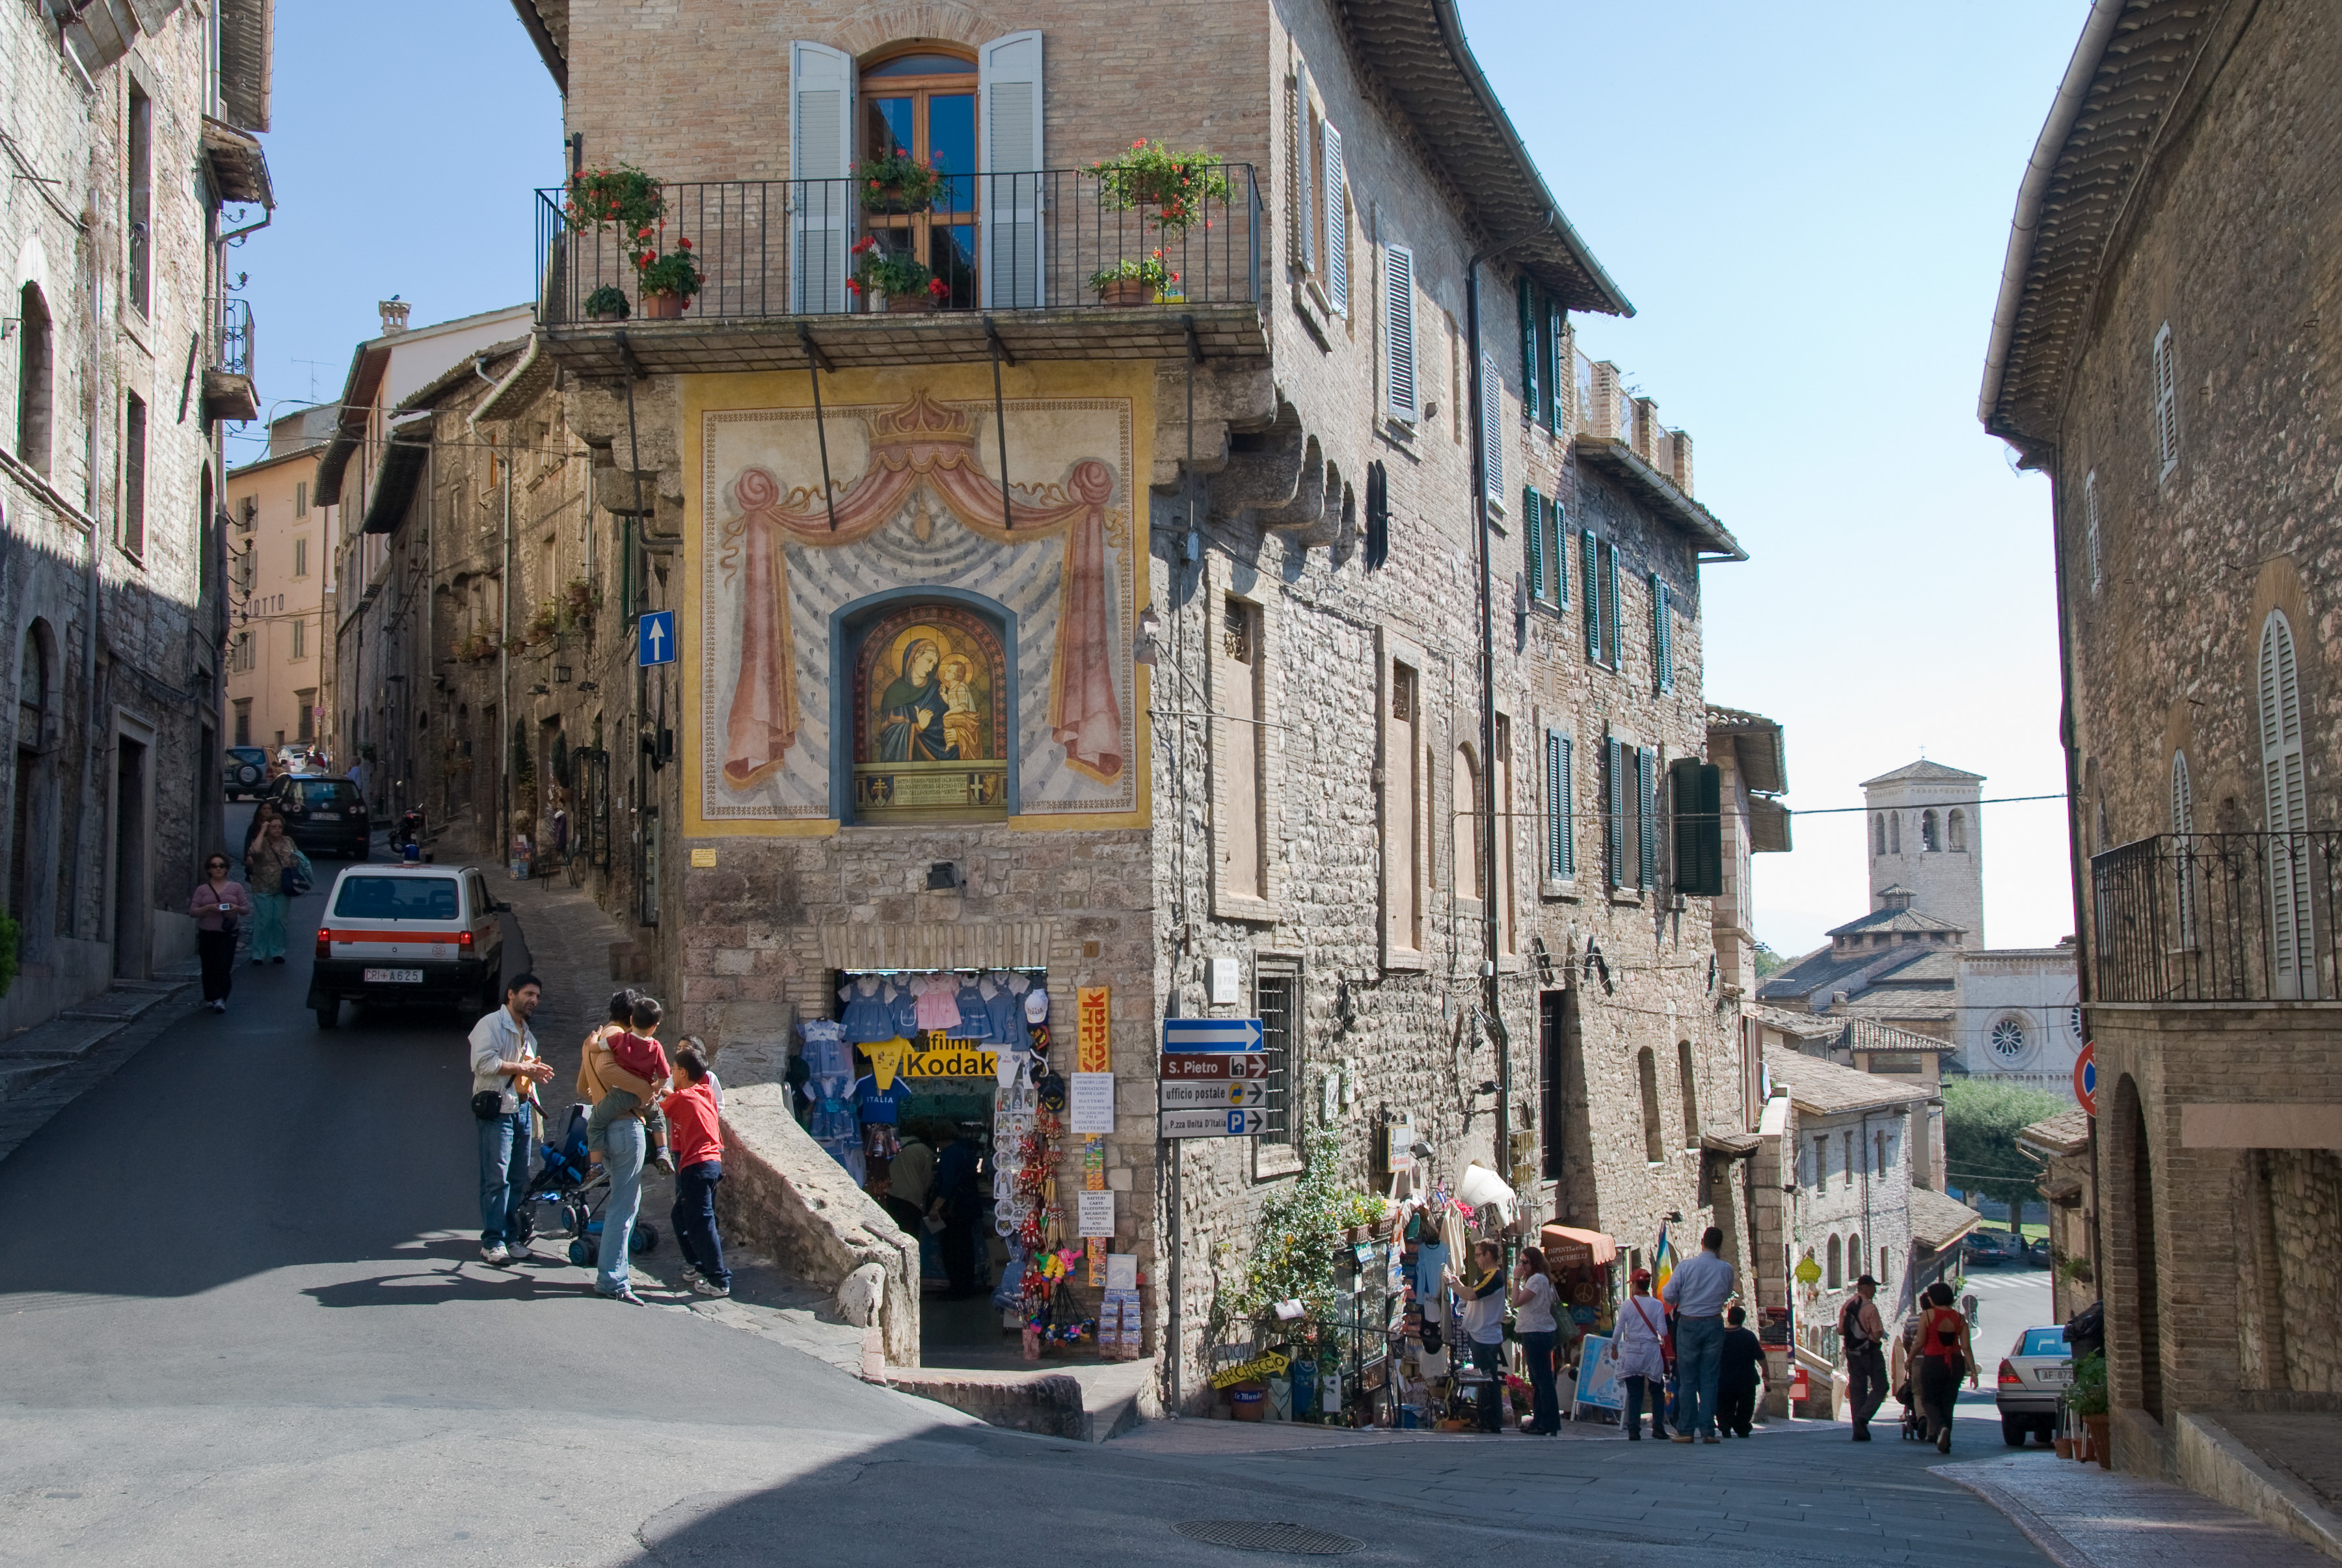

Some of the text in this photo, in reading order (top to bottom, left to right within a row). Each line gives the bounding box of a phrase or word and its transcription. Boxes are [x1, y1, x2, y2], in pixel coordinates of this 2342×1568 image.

[366, 970, 418, 980] CRI A625
[930, 1033, 970, 1051] film
[907, 1053, 996, 1076] Kodak
[1168, 1061, 1218, 1074] S. Pietro
[1166, 1087, 1225, 1102] ufficio postale
[1170, 1120, 1185, 1129] P.zza
[1187, 1119, 1203, 1128] Unità
[1205, 1119, 1226, 1128] D'Italia
[1548, 1246, 1571, 1254] DIPINTI
[1549, 1253, 1587, 1263] ACQUERELLI
[1217, 1344, 1256, 1360] EDICOLA
[1209, 1357, 1285, 1388] PARCHEGGIO
[1241, 1392, 1262, 1400] Monde
